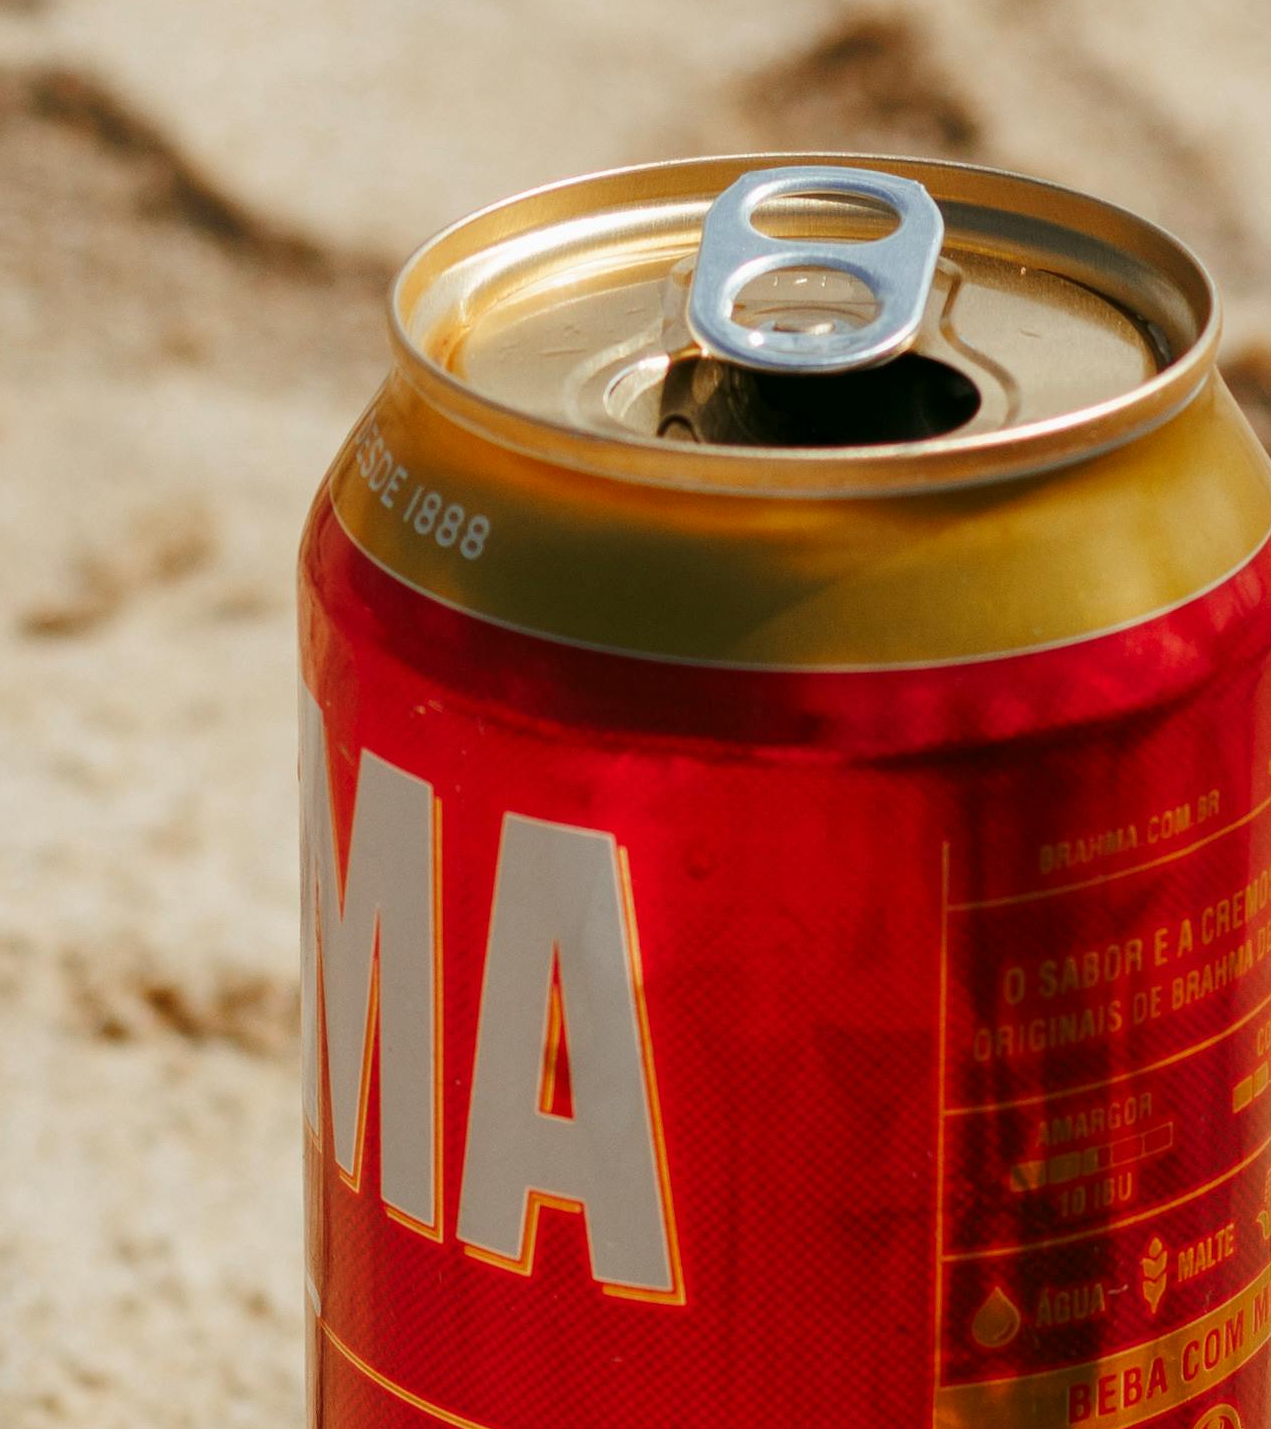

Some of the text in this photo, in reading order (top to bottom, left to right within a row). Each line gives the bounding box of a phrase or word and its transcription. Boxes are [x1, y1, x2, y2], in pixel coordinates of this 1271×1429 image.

[403, 484, 490, 561] 1888
[301, 683, 686, 1306] MA
[972, 999, 1123, 1063] ORIGINAIS
[1133, 985, 1163, 1026] DE
[1171, 938, 1254, 1011] BRAHMA
[1003, 966, 1026, 1006] O
[1036, 938, 1143, 1001] SABOR
[1154, 927, 1169, 967] E
[1177, 918, 1193, 958] A
[1035, 1092, 1154, 1148] AMARGOR
[1178, 1223, 1235, 1283] MALTE
[1067, 1357, 1168, 1426] BEBA
[1181, 1310, 1244, 1383] COM
